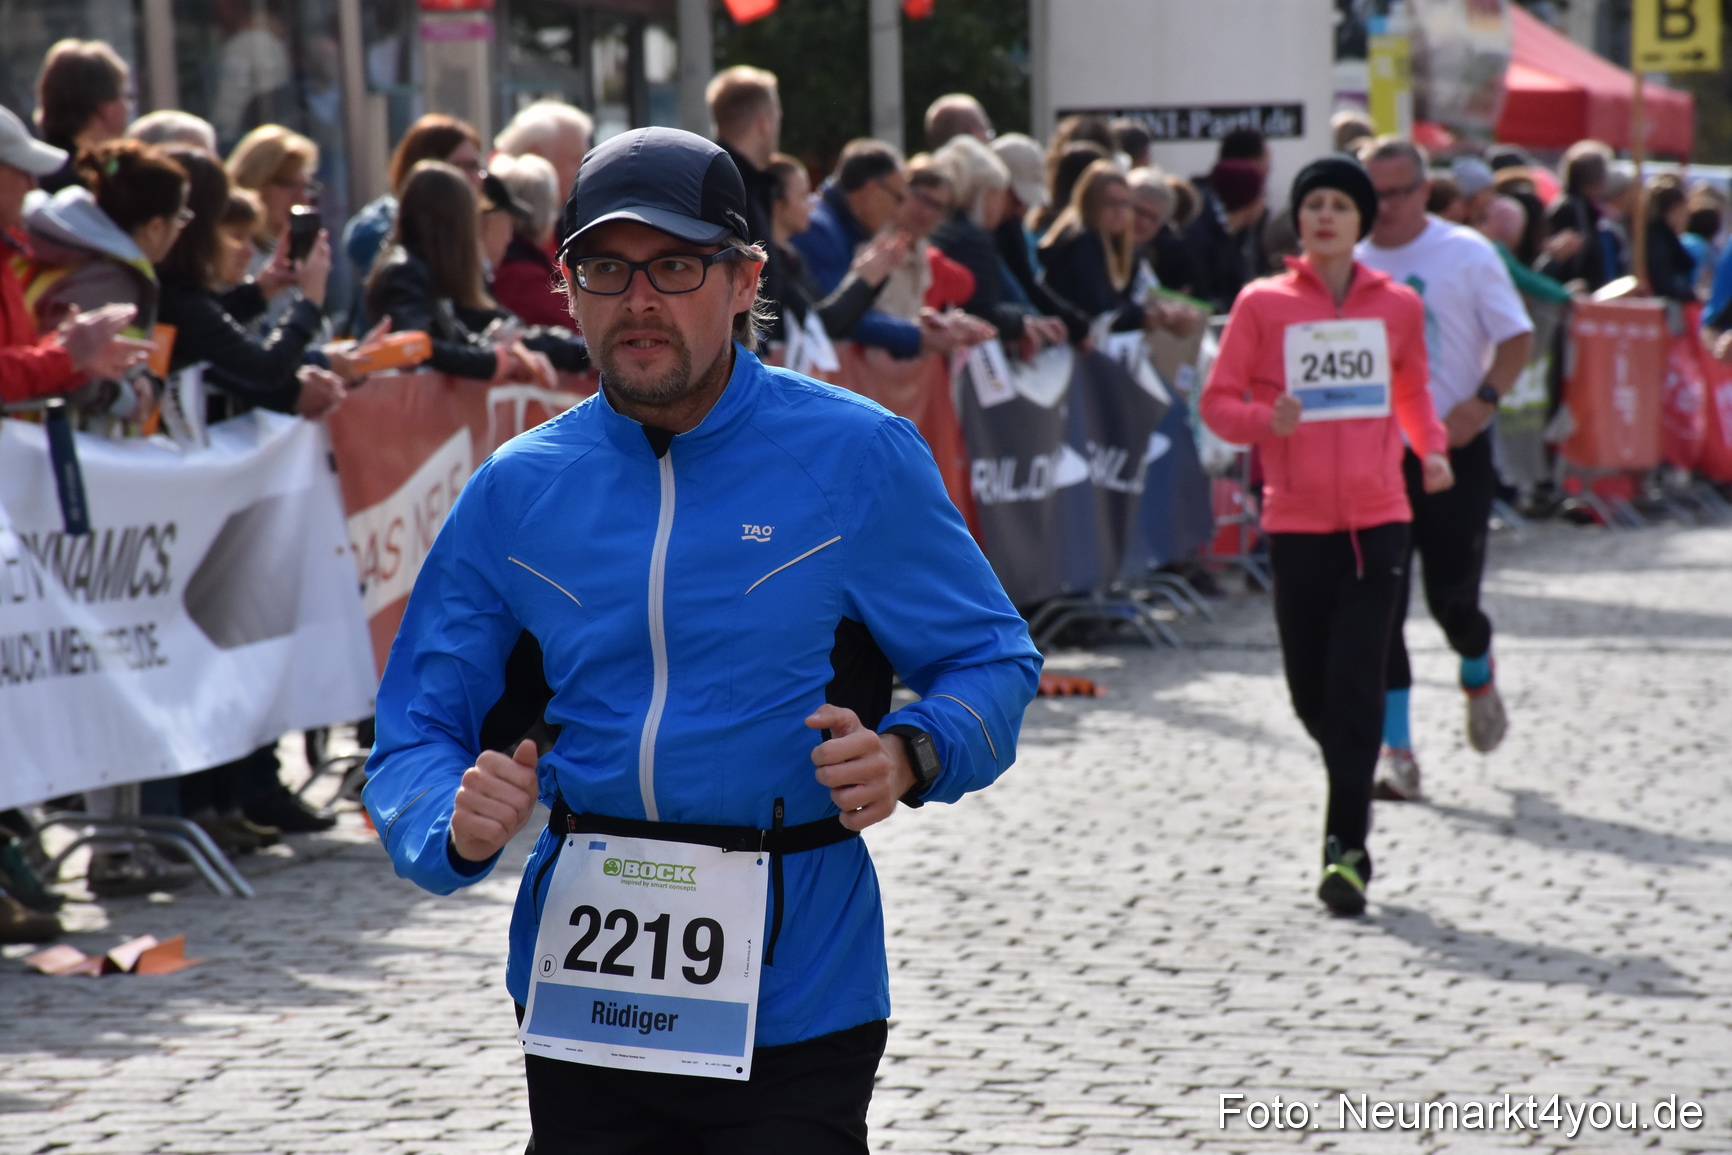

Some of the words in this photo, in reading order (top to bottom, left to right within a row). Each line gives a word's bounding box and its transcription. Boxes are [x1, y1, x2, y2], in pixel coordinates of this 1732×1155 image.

[1657, 0, 1697, 42] B
[1300, 349, 1374, 383] 2450
[742, 524, 772, 536] TAO
[621, 879, 642, 887] inspired
[669, 884, 696, 892] concepts
[622, 859, 696, 884] BOCK
[563, 905, 724, 985] 2219
[544, 960, 551, 972] D
[591, 1000, 679, 1034] Rüdiger
